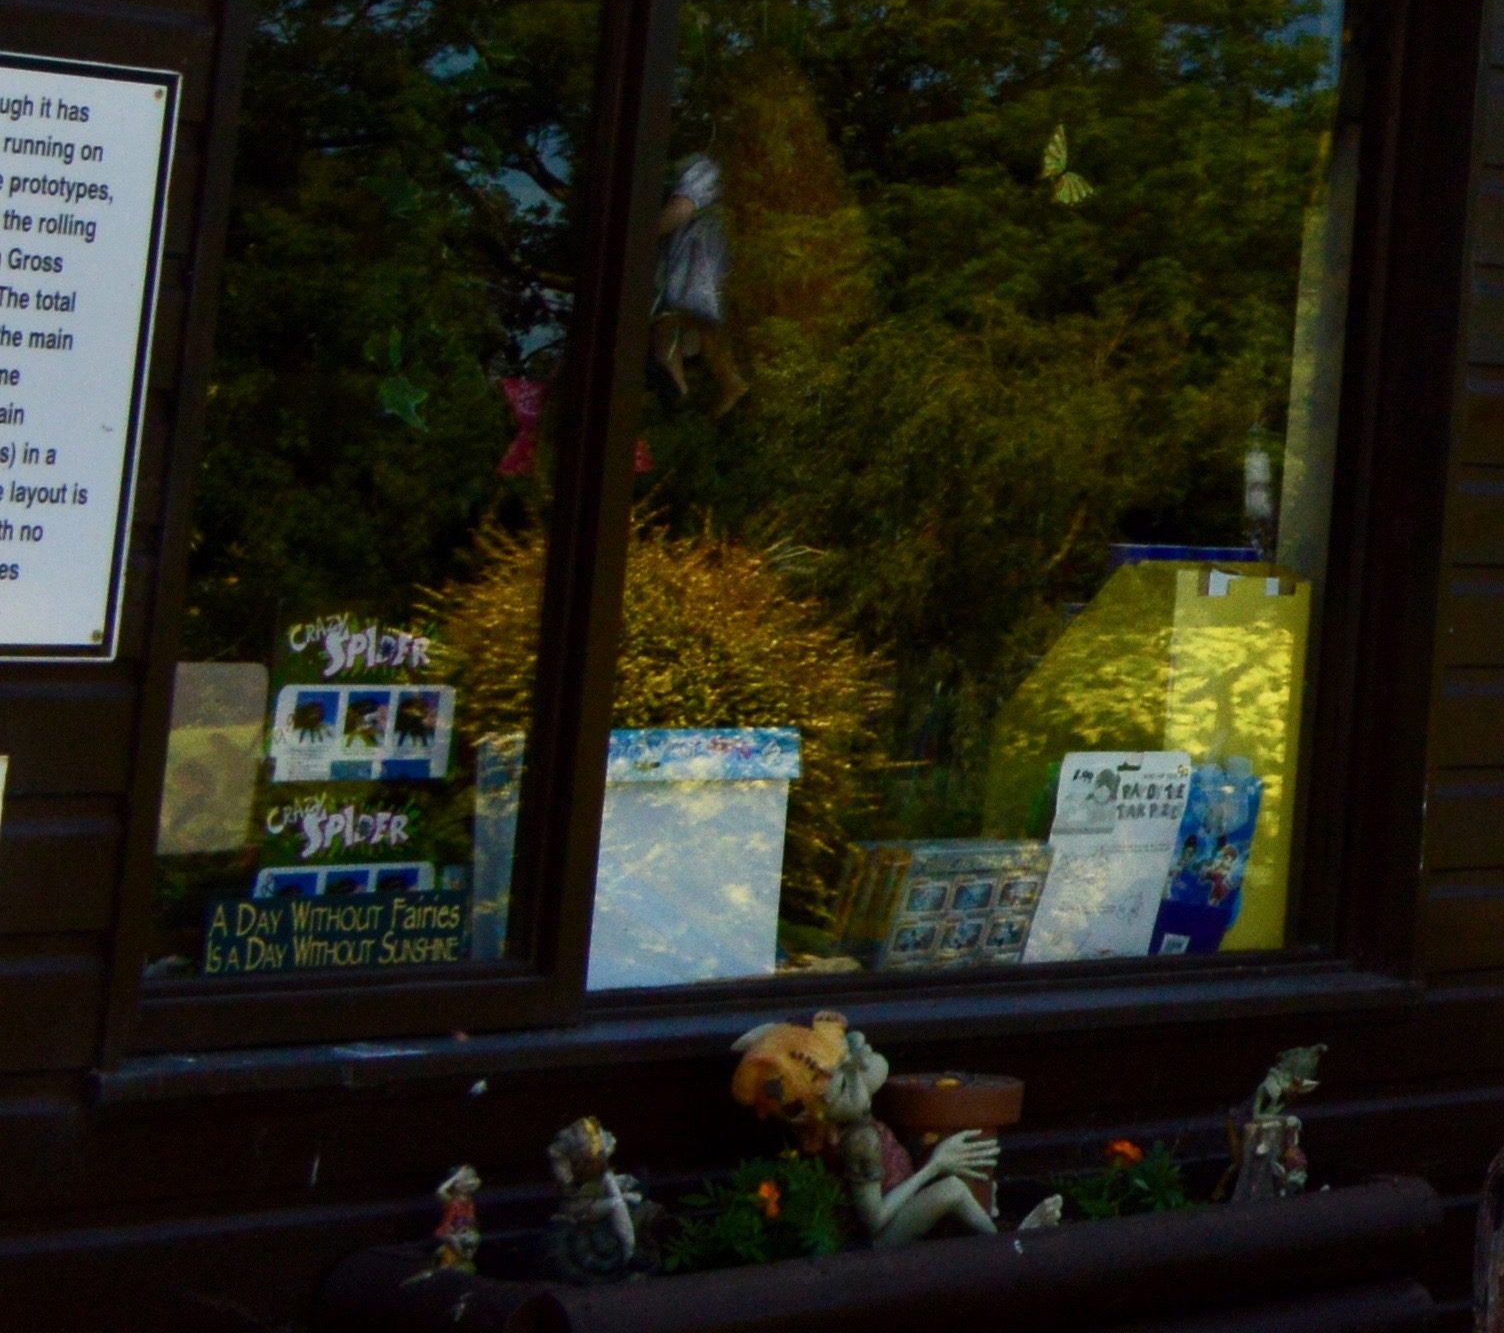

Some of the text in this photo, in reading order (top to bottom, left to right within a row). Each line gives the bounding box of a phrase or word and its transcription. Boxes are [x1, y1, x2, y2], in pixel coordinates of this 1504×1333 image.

[40, 95, 52, 119] it
[56, 98, 90, 123] has
[3, 135, 104, 165] running on
[9, 174, 114, 204] prototypes,
[3, 209, 98, 244] the rolling
[7, 247, 64, 274] Gross
[35, 290, 76, 313] total
[0, 324, 74, 351] he main
[22, 442, 40, 465] in
[45, 446, 57, 466] a
[9, 480, 68, 510] layout
[71, 482, 89, 506] is
[20, 524, 44, 543] no
[322, 625, 431, 677] SPIDER
[300, 804, 410, 859] SPIDER
[211, 903, 228, 937] A
[389, 894, 461, 930] Fairies
